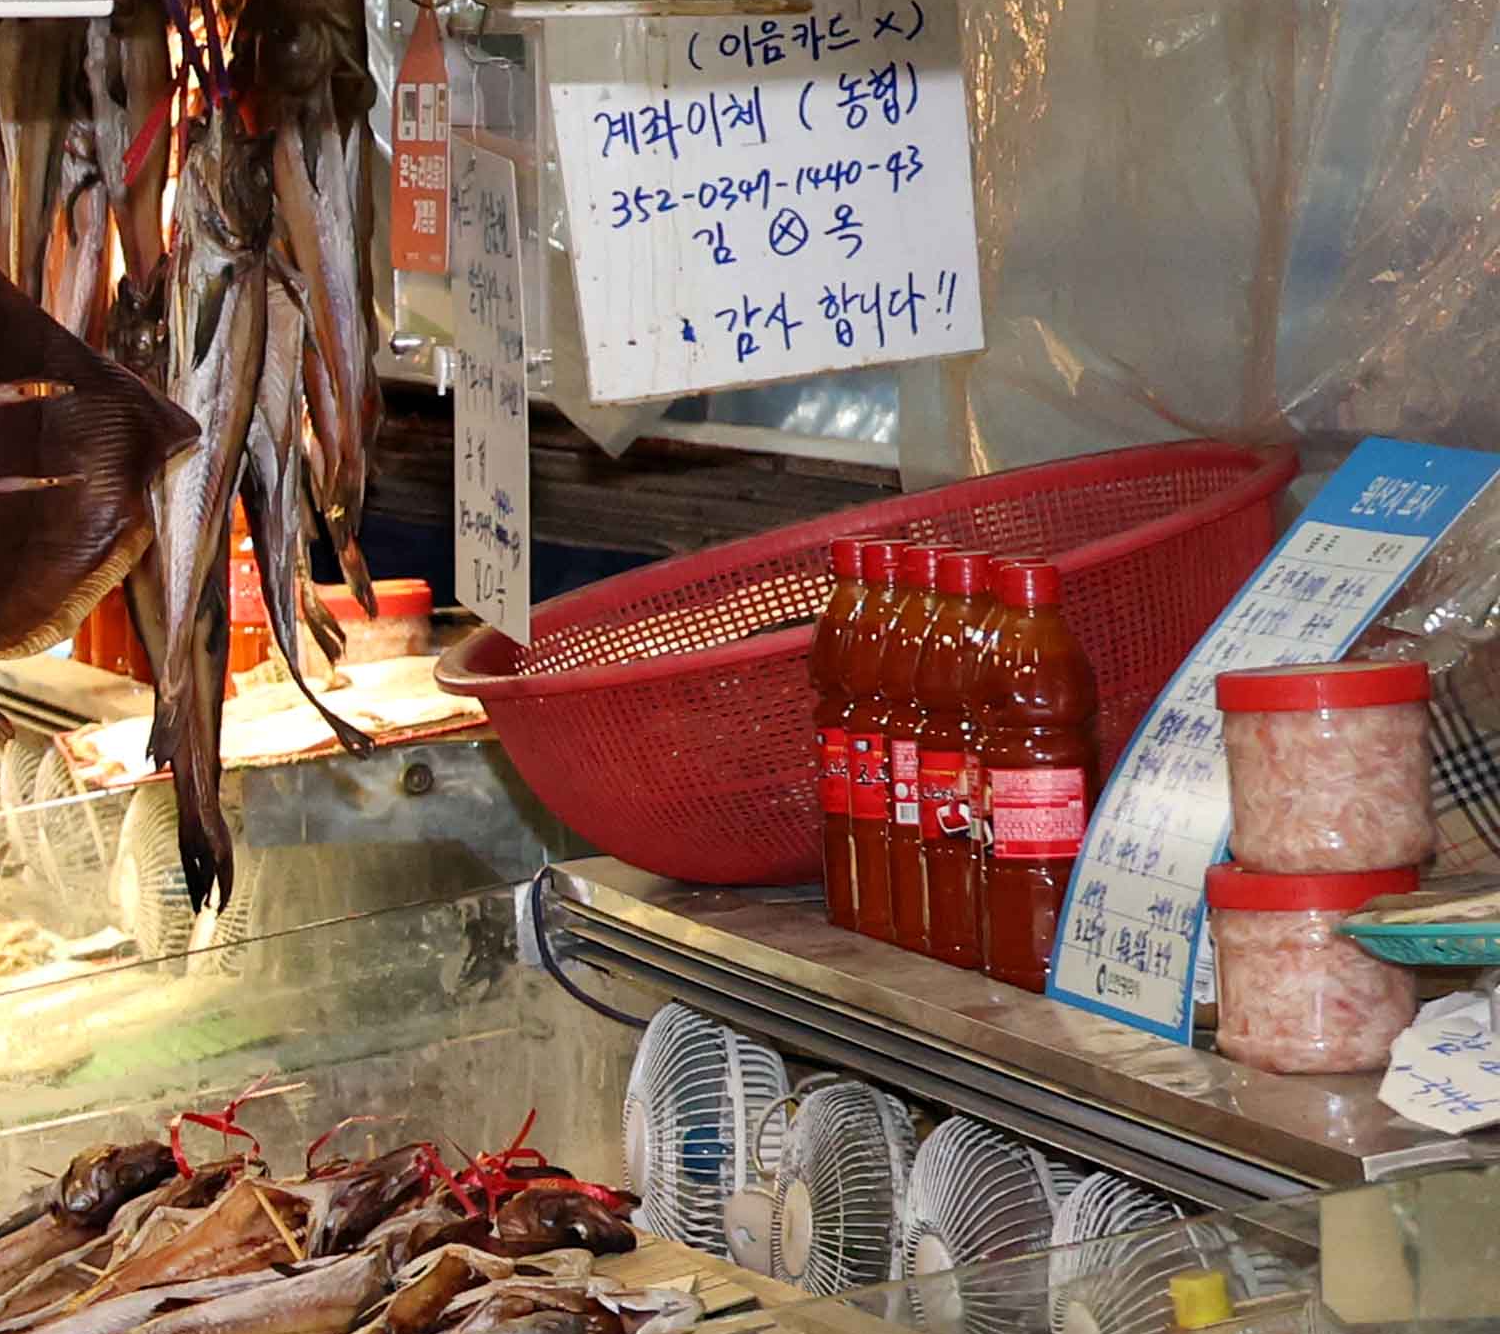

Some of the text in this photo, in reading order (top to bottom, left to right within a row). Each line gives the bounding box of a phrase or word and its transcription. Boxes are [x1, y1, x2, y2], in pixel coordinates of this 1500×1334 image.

[594, 86, 767, 159] 계좌이체
[691, 221, 737, 265] 김
[714, 270, 958, 363] 감사 합니다!!
